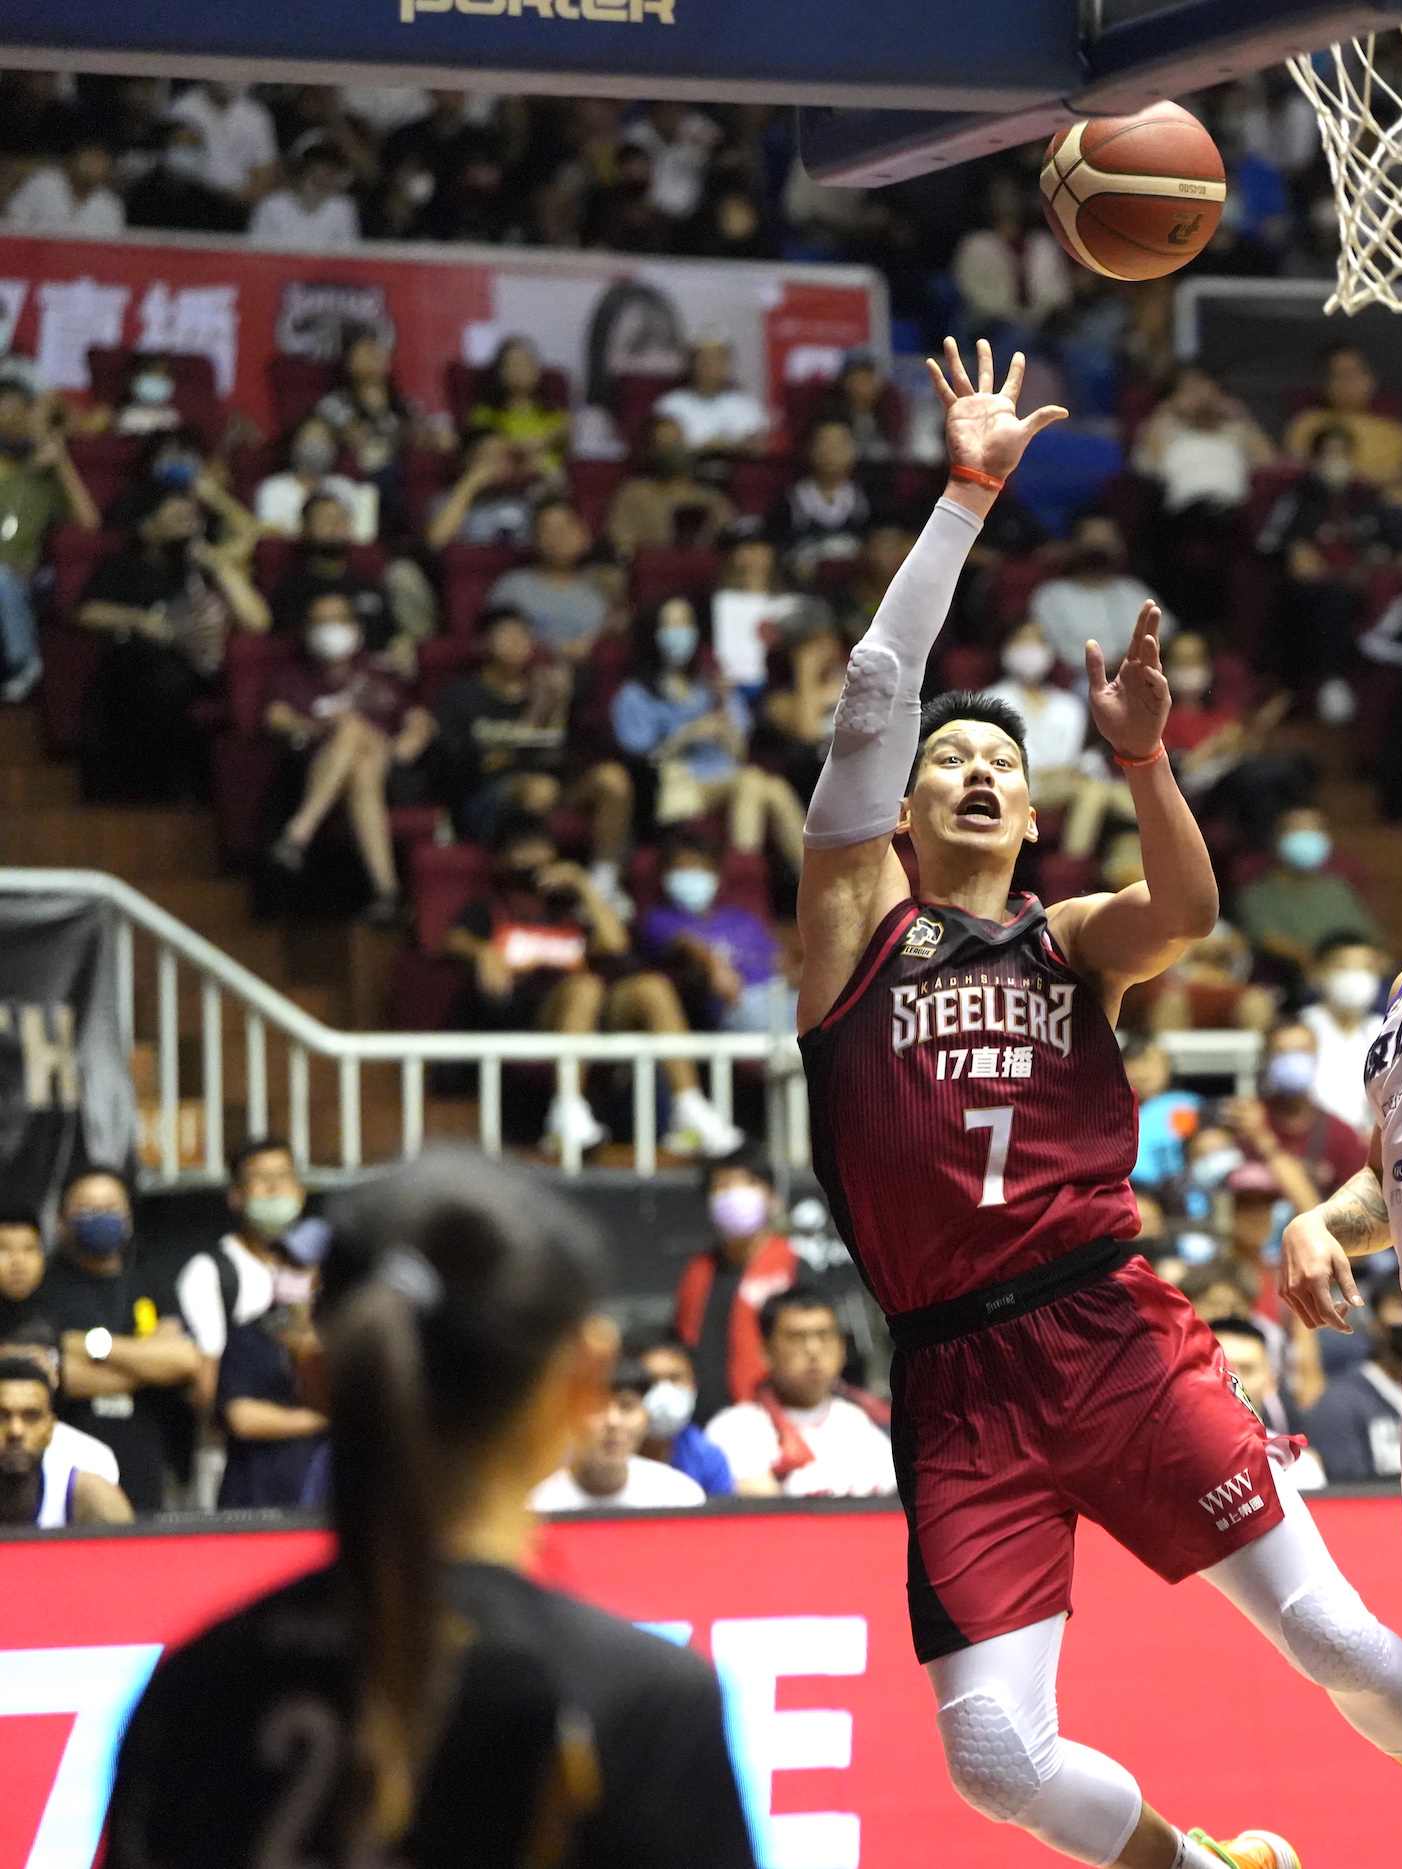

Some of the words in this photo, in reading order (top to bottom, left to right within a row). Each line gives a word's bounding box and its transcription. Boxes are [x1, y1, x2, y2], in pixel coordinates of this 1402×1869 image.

[920, 974, 1043, 994] KAOHSIUNG
[890, 983, 1077, 1059] STEELERS
[936, 1046, 1034, 1081] 17直播
[963, 1105, 1015, 1208] 7
